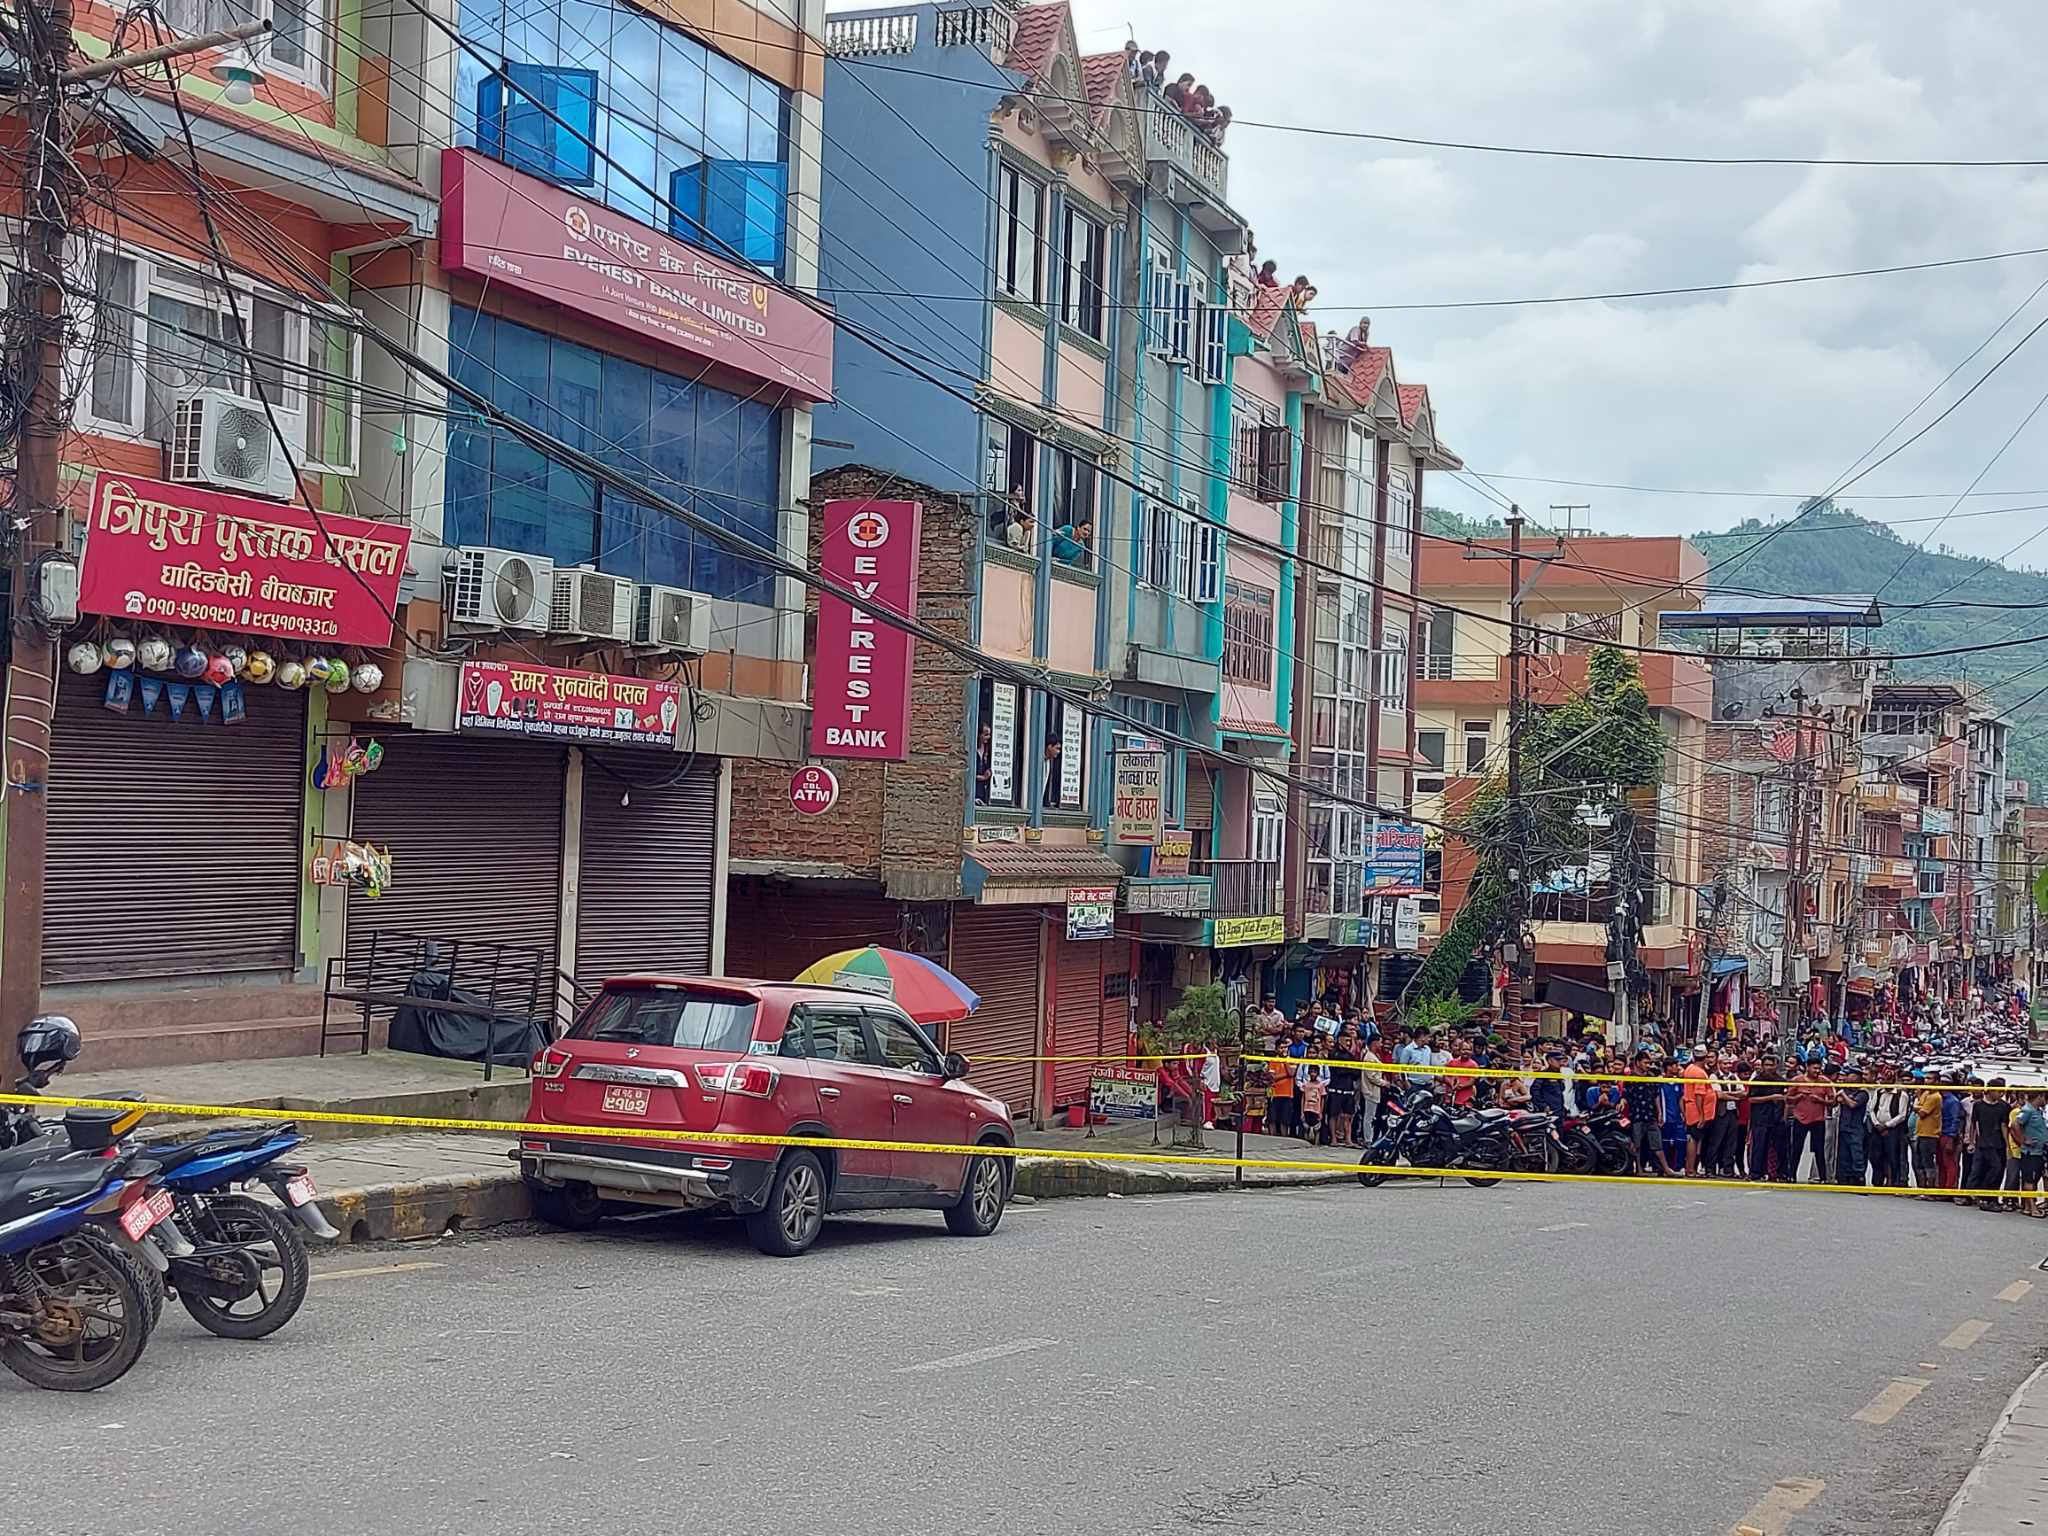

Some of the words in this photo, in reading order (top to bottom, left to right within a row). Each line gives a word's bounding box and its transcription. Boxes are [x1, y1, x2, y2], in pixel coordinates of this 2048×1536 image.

[659, 245, 686, 273] बैंक
[563, 245, 646, 288] EVEREST
[649, 281, 698, 309] BANK
[702, 301, 767, 337] LIMITED
[98, 481, 207, 550] त्रिपुरा
[215, 514, 317, 561] पुस्तक
[324, 535, 402, 575] पसल
[260, 576, 337, 610] बीचबजार
[252, 610, 338, 636] ९८५१०१३३८७
[845, 556, 879, 723] EVEREST
[510, 670, 549, 695] समर
[612, 682, 650, 705] पसल
[826, 728, 887, 748] BANK
[793, 789, 830, 802] ATM
